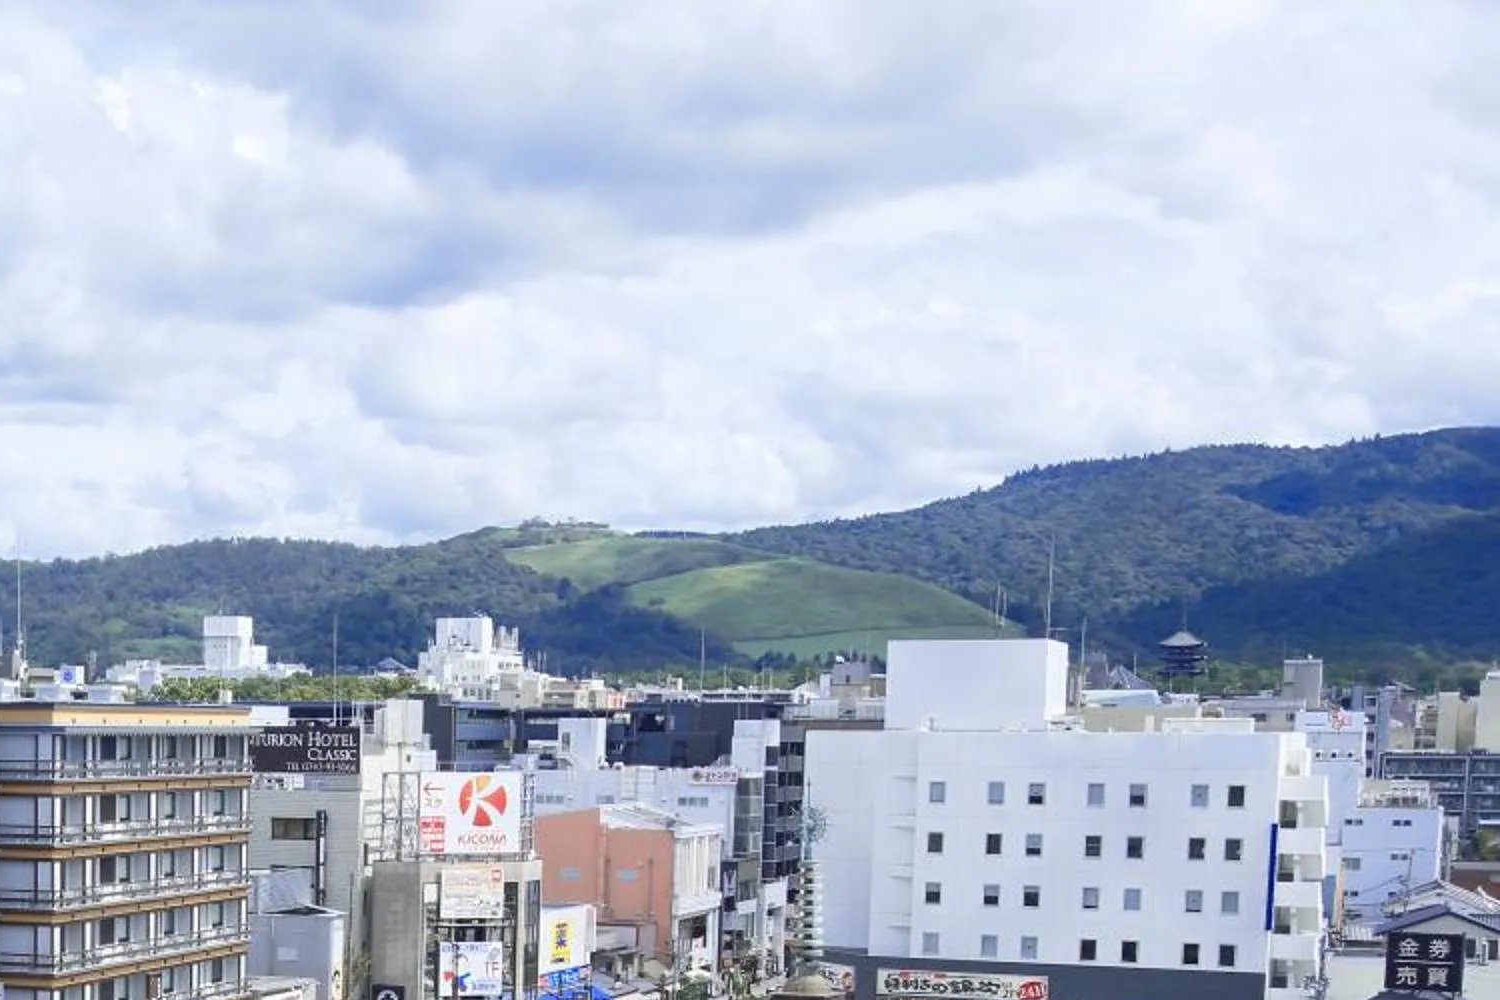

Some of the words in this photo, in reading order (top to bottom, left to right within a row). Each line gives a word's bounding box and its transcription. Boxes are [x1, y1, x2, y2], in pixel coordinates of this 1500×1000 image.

[308, 731, 356, 747] HOTEL
[307, 748, 357, 761] CLASSIC
[1398, 938, 1449, 959] 金券
[1396, 966, 1448, 987] 売買
